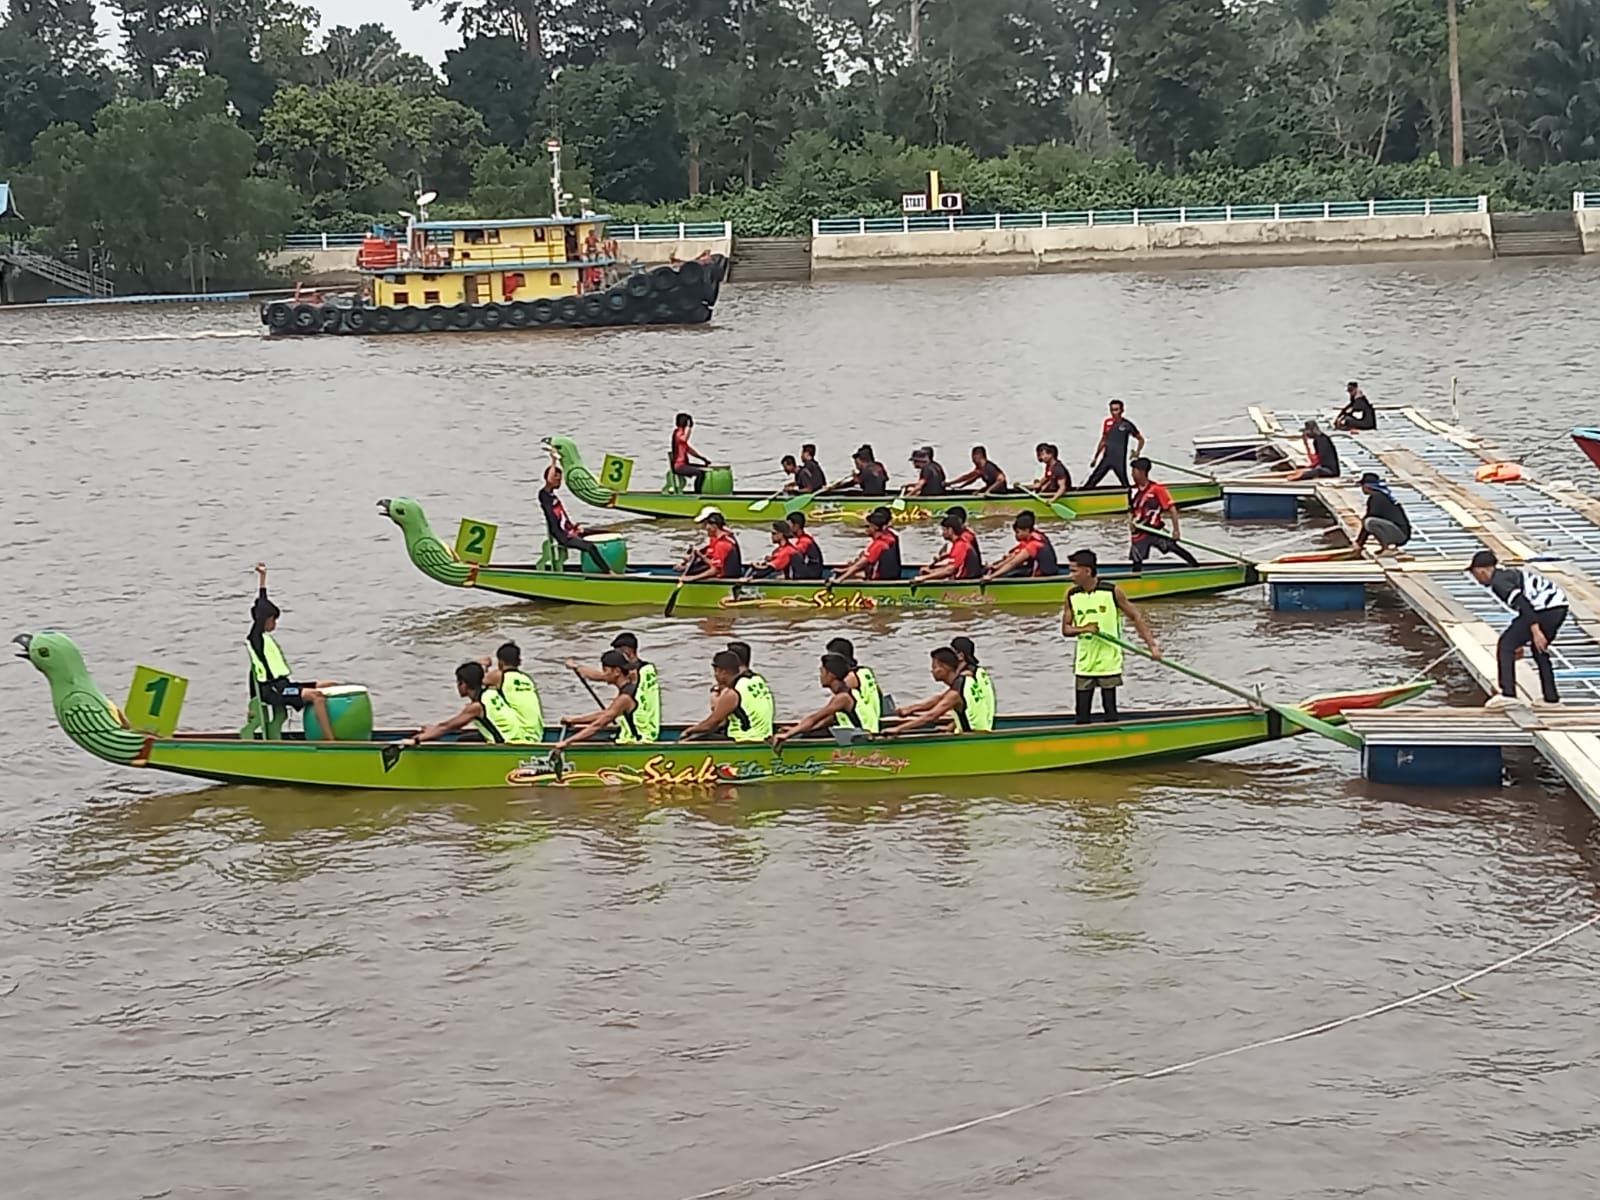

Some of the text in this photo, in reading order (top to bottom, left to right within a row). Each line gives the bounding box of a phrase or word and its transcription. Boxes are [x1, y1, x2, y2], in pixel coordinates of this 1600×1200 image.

[904, 197, 925, 209] START
[607, 460, 625, 483] 3
[464, 526, 487, 555] 2
[812, 588, 865, 609] Siak
[144, 676, 170, 717] 1
[643, 752, 718, 784] Siak
